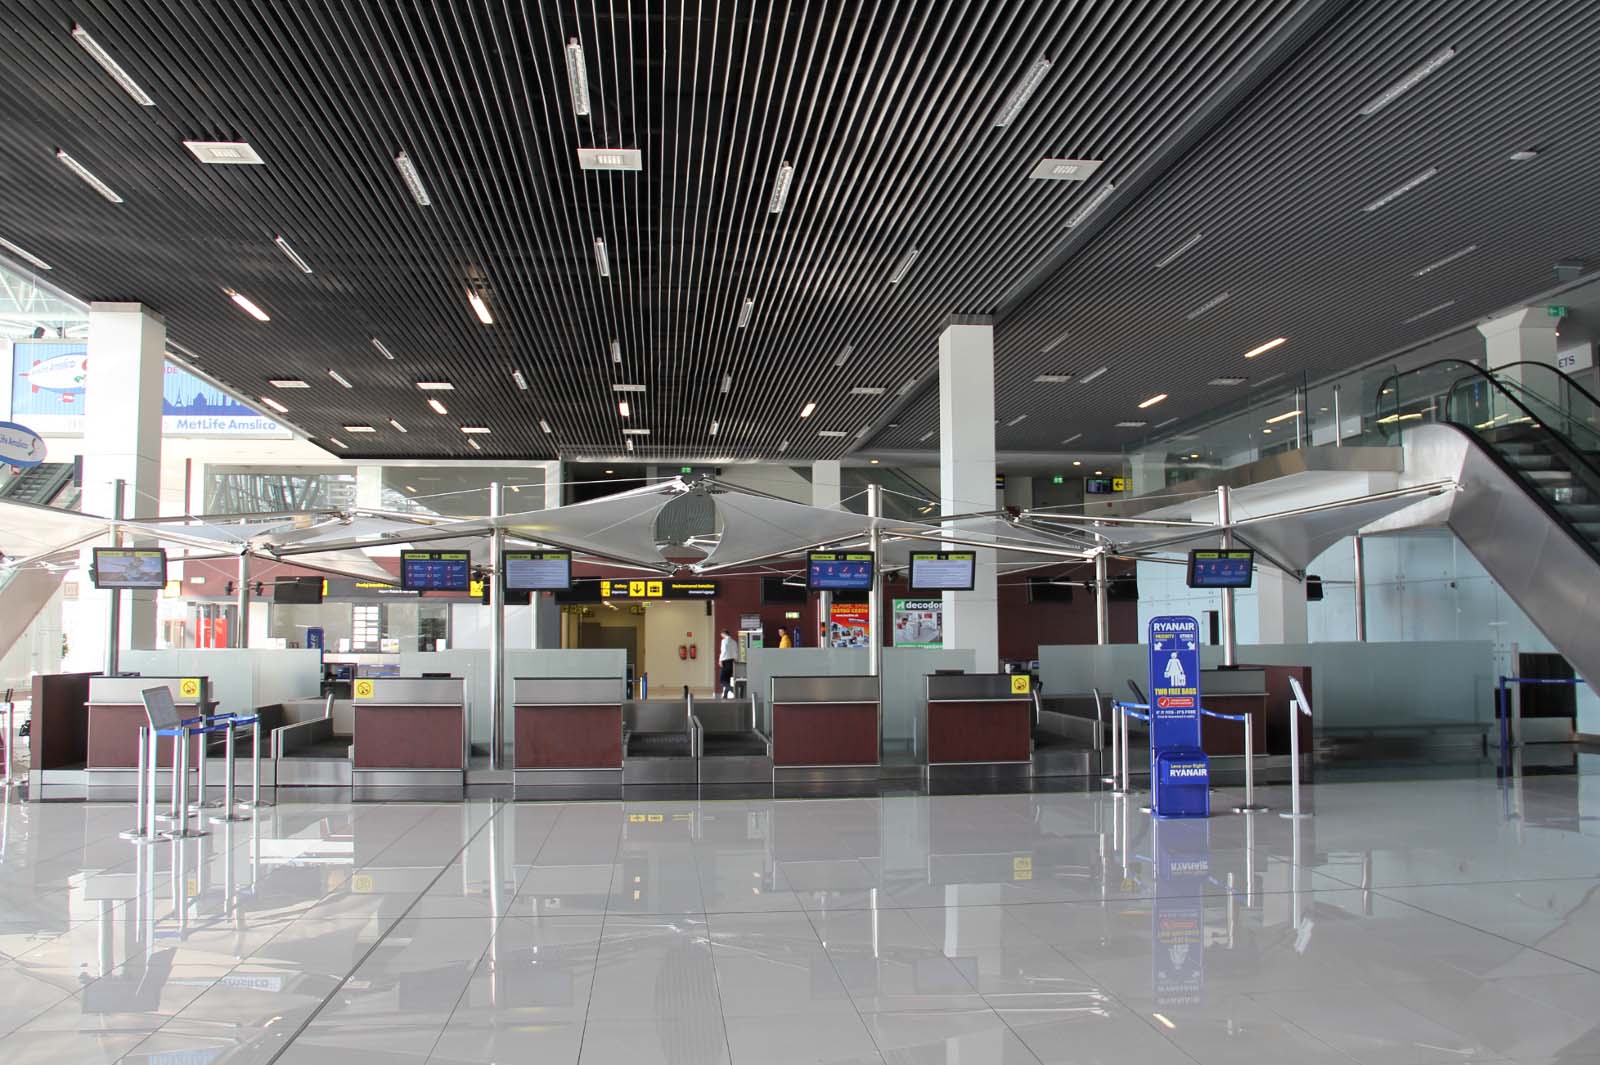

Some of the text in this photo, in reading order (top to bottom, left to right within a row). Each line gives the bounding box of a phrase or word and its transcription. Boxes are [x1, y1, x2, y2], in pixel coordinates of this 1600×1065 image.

[176, 417, 277, 430] MetLife Amslico
[1153, 622, 1195, 631] RYANAIR
[1169, 768, 1208, 777] RYANAIR
